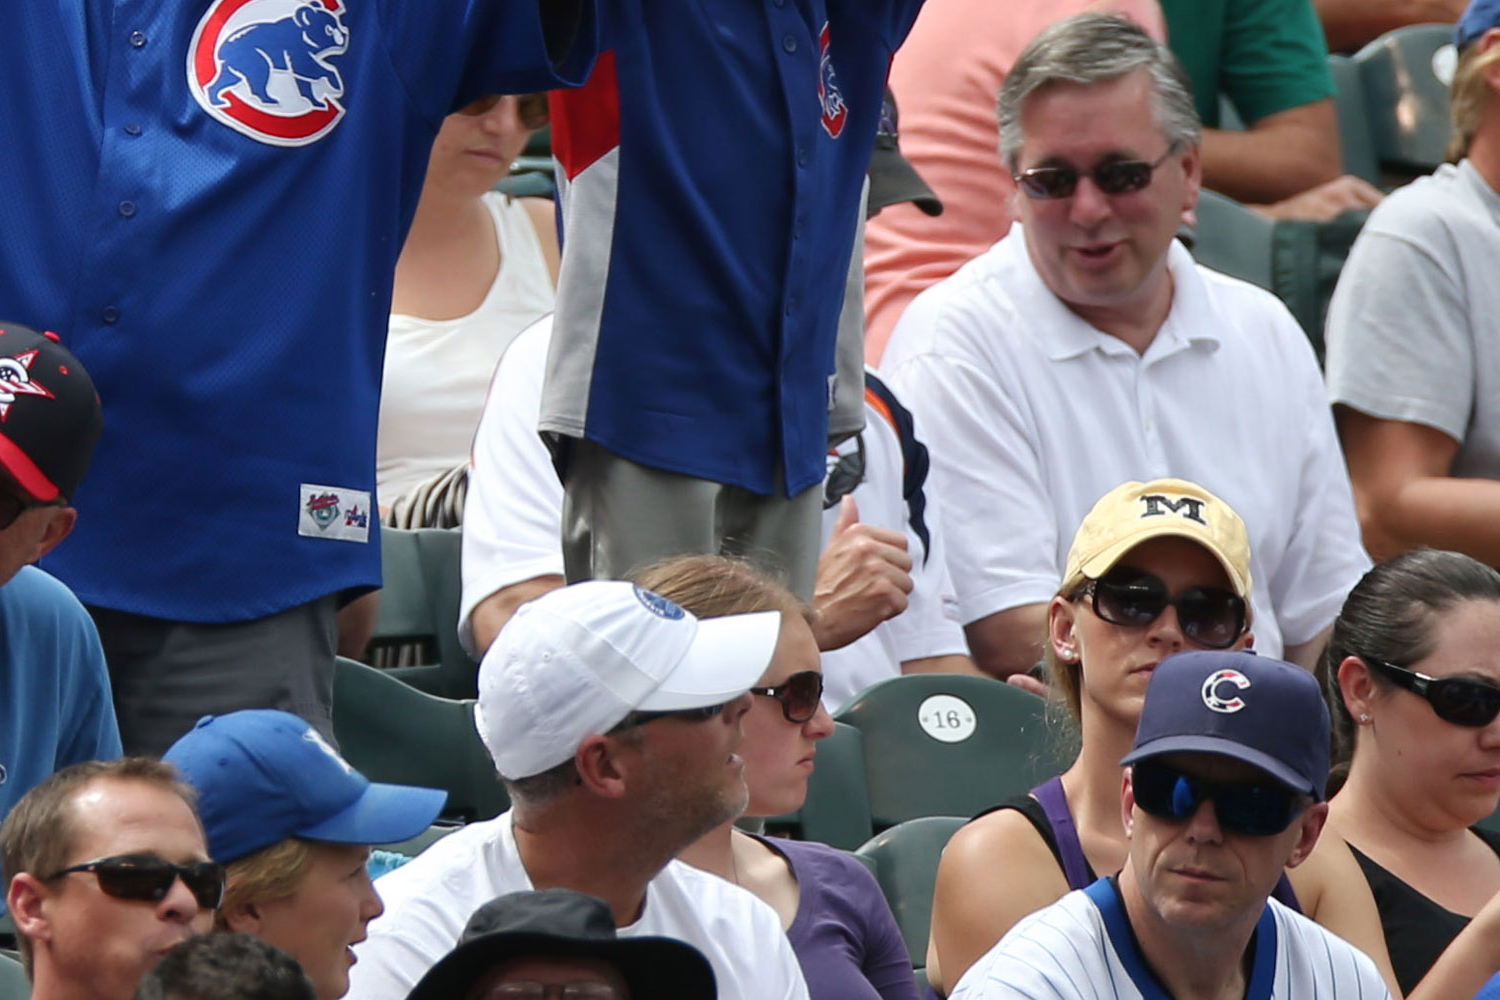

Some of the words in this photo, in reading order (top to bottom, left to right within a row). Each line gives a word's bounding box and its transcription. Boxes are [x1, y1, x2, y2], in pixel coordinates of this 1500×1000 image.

[1139, 494, 1207, 526] M
[1202, 668, 1251, 714] C
[933, 709, 962, 729] 16
